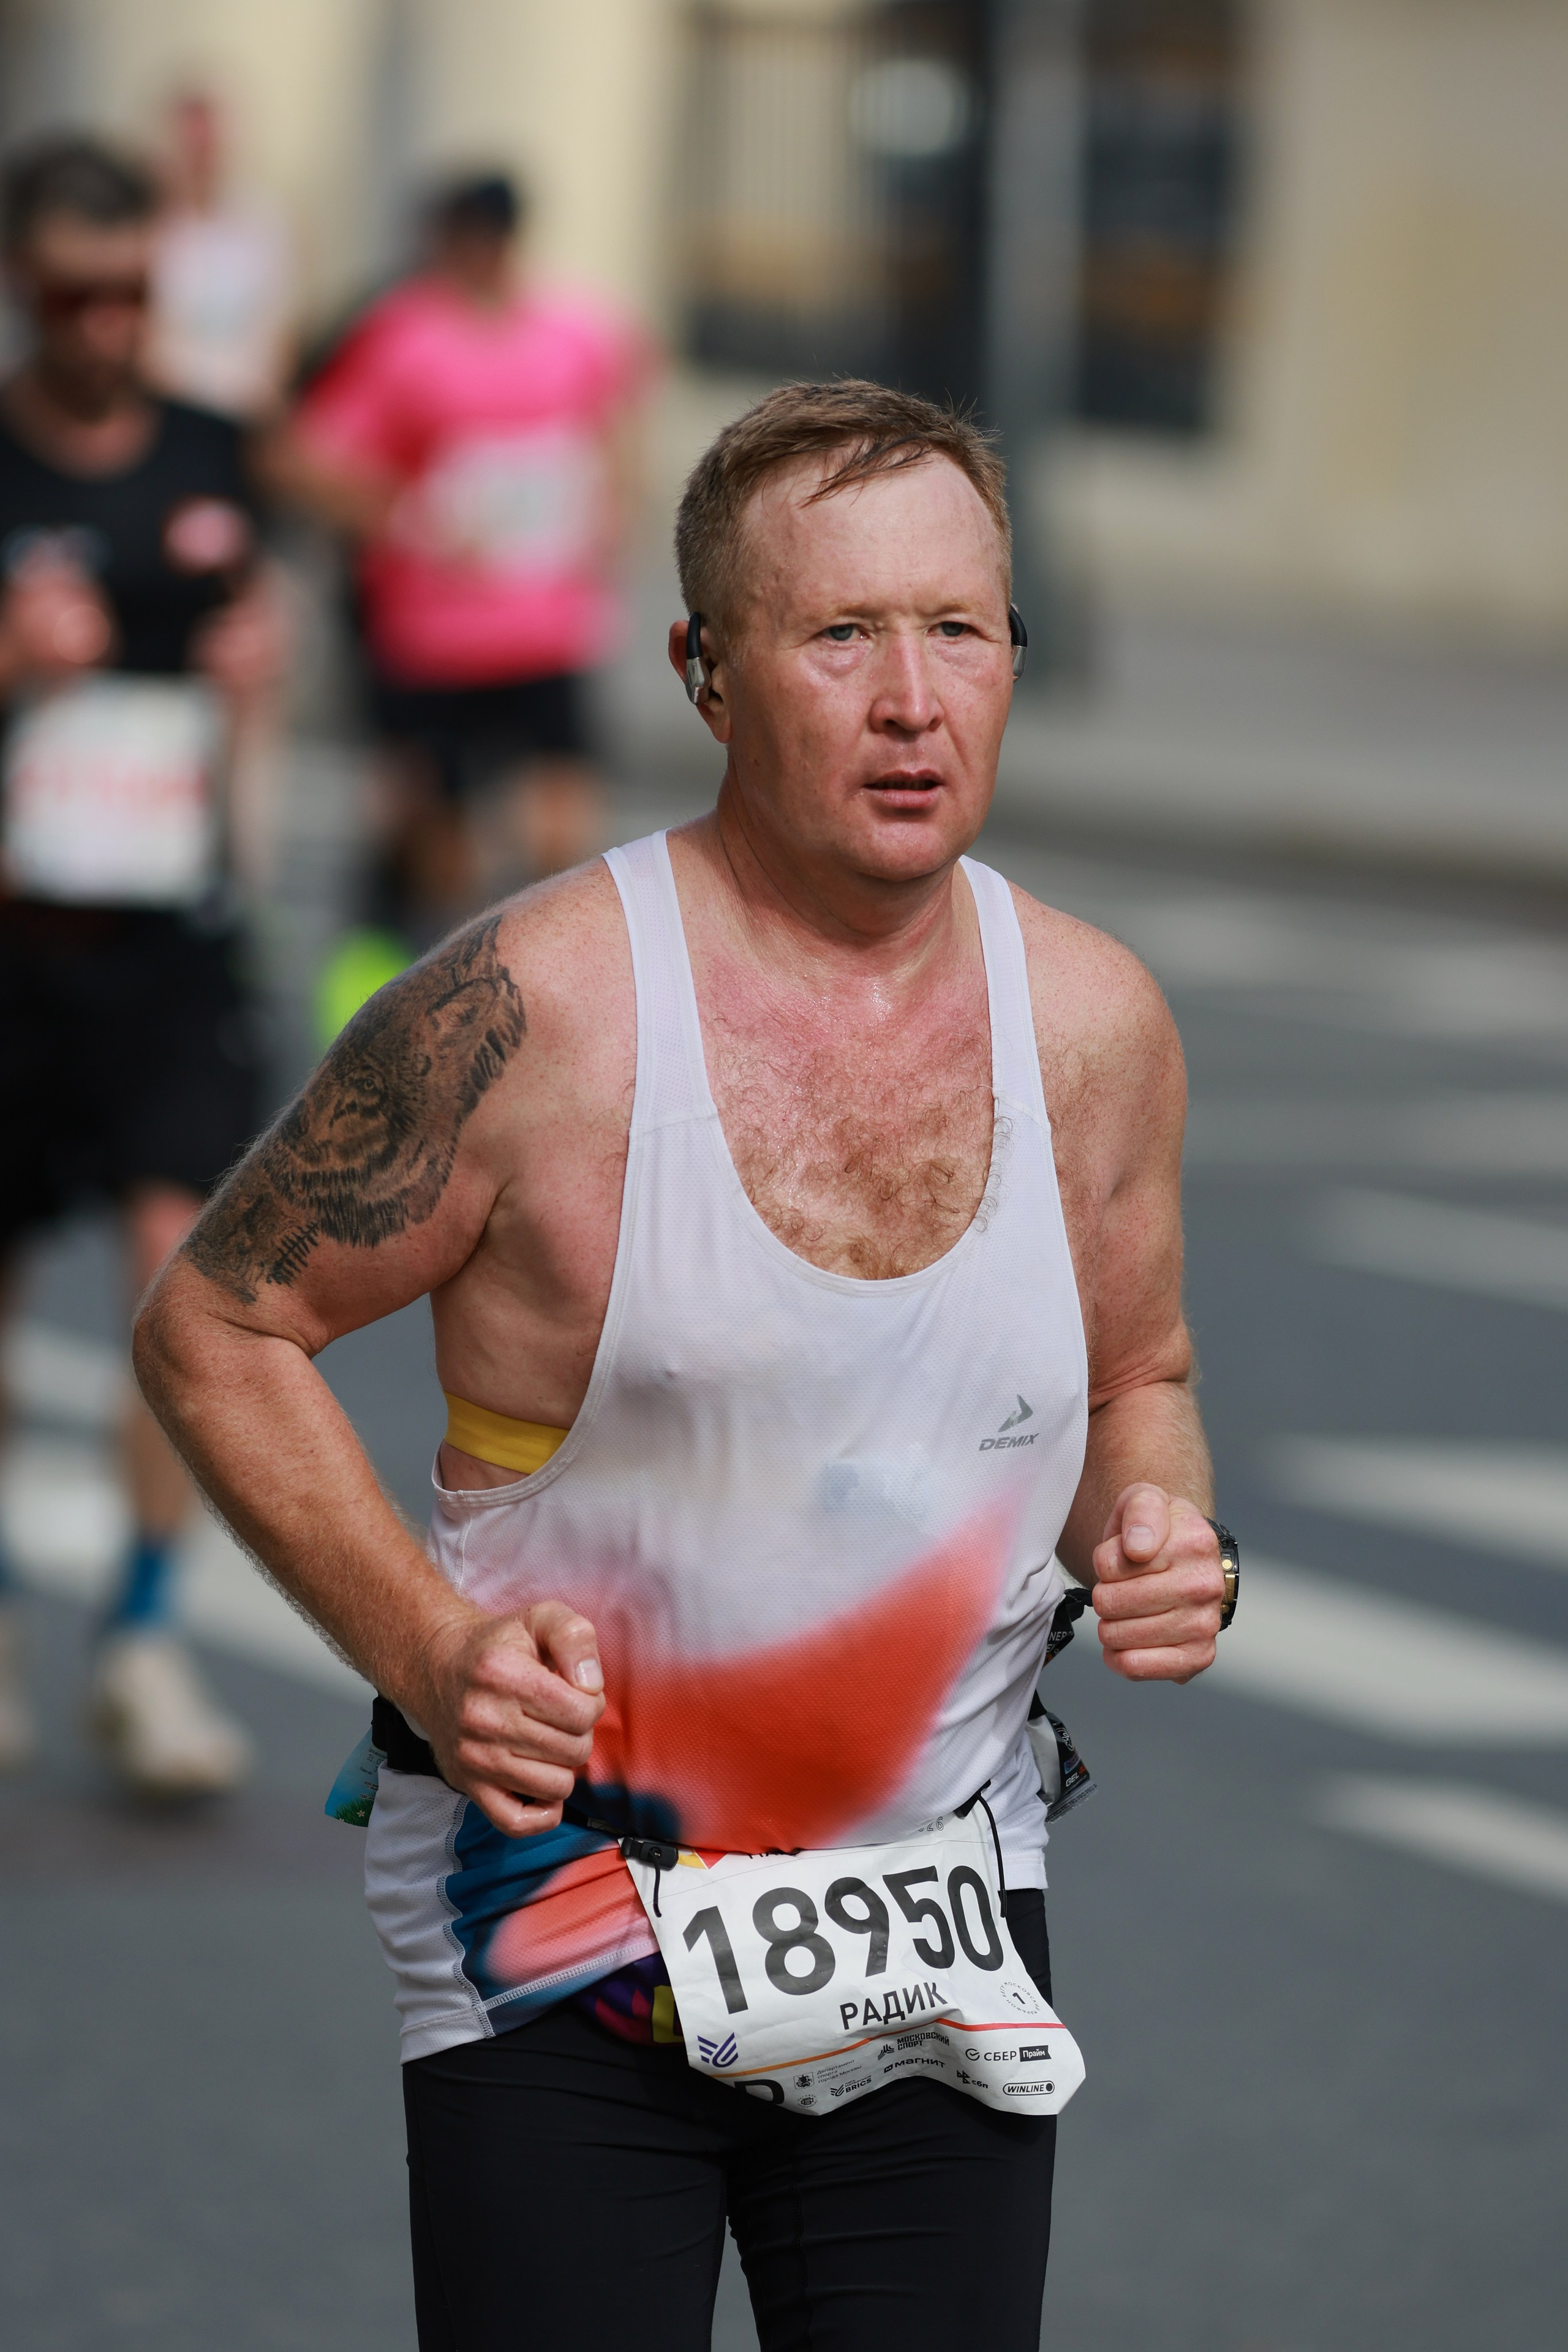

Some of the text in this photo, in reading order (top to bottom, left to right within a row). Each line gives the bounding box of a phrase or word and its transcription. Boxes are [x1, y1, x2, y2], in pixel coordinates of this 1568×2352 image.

[979, 1433, 1040, 1451] DEMIX
[1066, 1772, 1080, 1787] GEL
[918, 1816, 944, 1832] 26
[682, 1865, 1005, 2015] 18950
[840, 1982, 948, 2030] РАДИК
[1012, 1992, 1026, 2005] 1
[897, 2032, 949, 2046] МОСКОВСКИЙ
[897, 2040, 924, 2051] СПОРТ
[984, 2048, 1046, 2061] СБЕР Прайм
[816, 2060, 855, 2076] Департамент
[817, 2070, 838, 2079] спорта
[818, 2065, 862, 2084] города Москвы
[845, 2078, 872, 2094] BRICS
[971, 2079, 989, 2089] сбп
[1008, 2084, 1044, 2093] WINLINE
